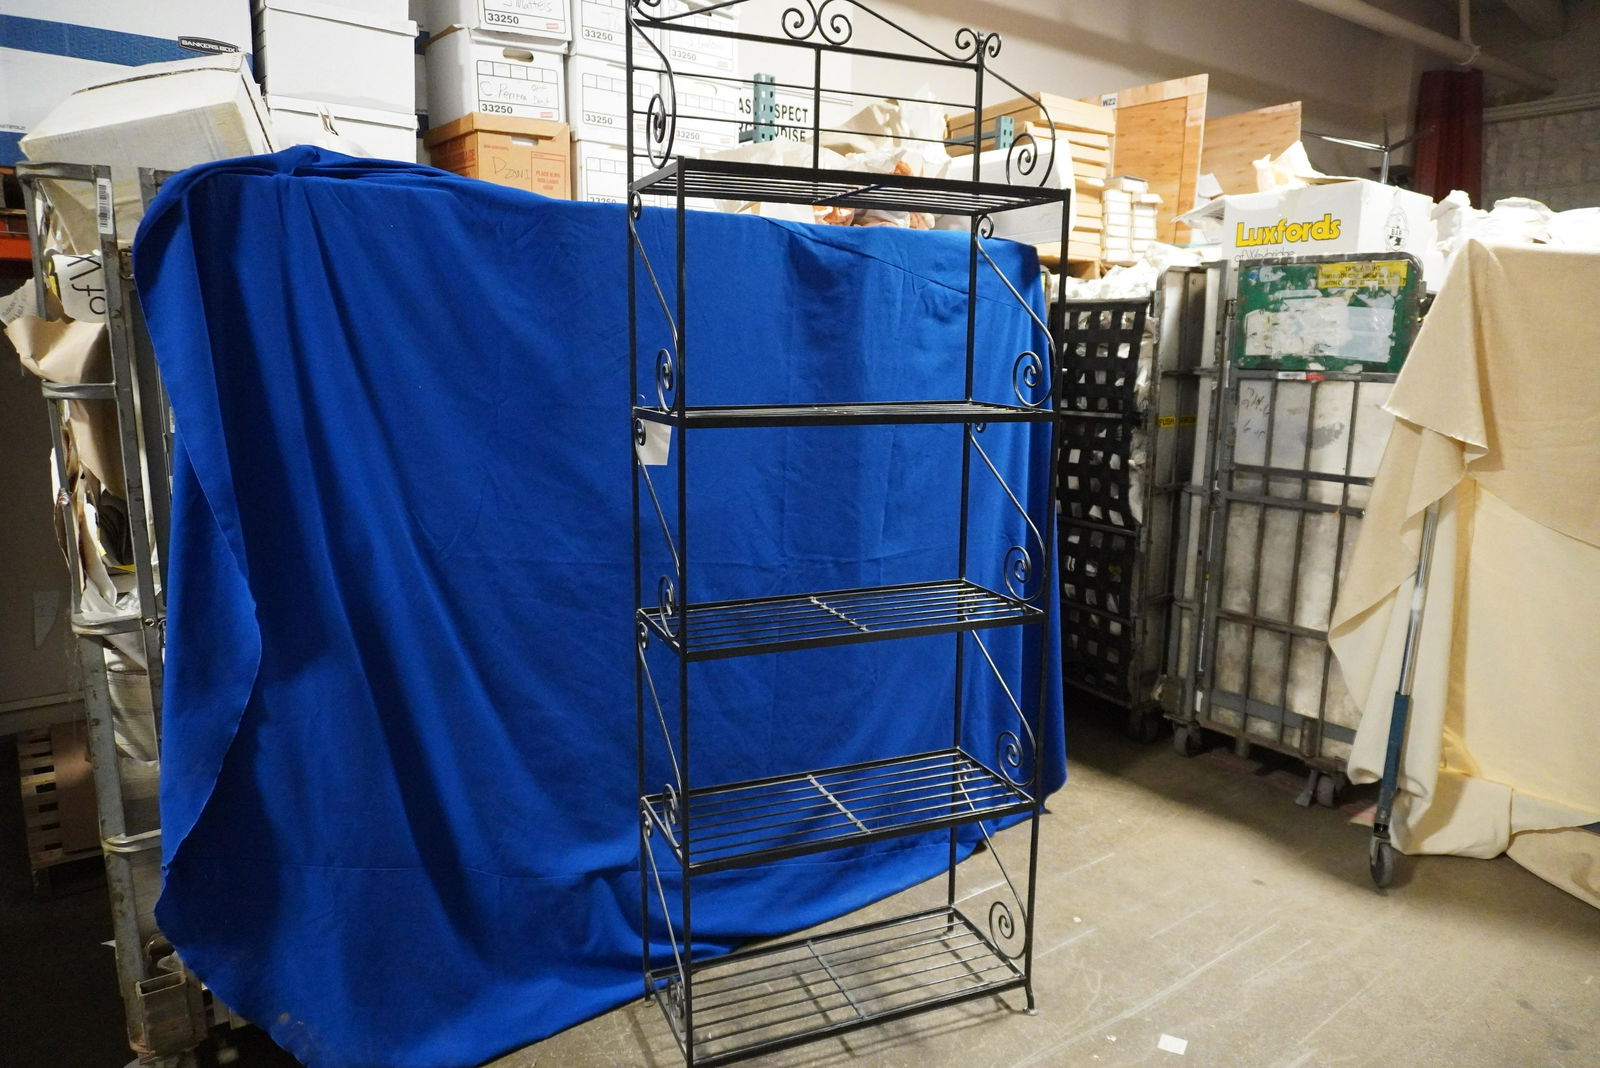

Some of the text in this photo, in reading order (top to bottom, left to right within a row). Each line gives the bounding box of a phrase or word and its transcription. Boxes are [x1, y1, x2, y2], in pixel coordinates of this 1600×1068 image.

[487, 13, 520, 25] 33250
[584, 29, 613, 42] 33250
[181, 39, 236, 53] BANKERS BOX
[671, 49, 697, 61] 33250
[482, 104, 513, 114] 33250
[774, 103, 809, 123] SPECT
[584, 113, 613, 125] 33250
[675, 130, 700, 141] 33250
[1235, 213, 1342, 248] Luxfords
